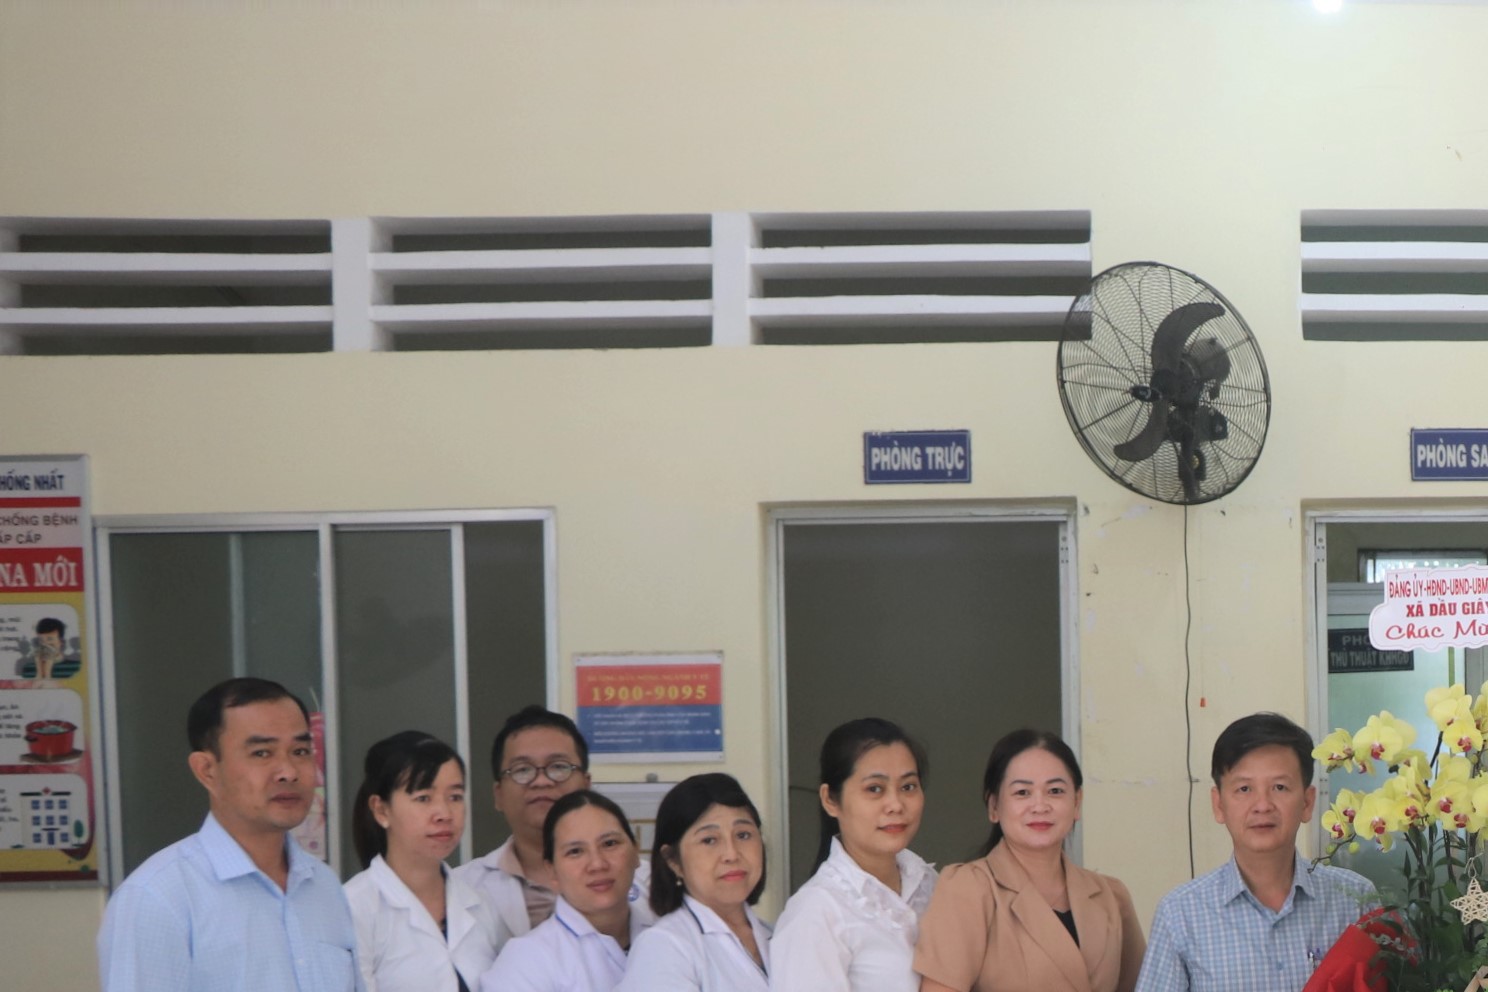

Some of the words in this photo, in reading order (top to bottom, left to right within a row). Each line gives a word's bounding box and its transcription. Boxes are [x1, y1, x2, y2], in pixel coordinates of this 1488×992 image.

[871, 440, 922, 470] PHÒNG
[926, 442, 964, 476] TRỰC
[1417, 438, 1467, 468] PHÒNG
[34, 468, 64, 490] NHẤT
[43, 513, 78, 527] BỆNH
[16, 530, 42, 544] CẤP
[1389, 574, 1411, 598] ĐẢNG
[1406, 600, 1424, 617] XÃ
[1430, 598, 1457, 616] DẦU
[1385, 623, 1444, 640] Chúc
[592, 684, 707, 701] 1900-9095
